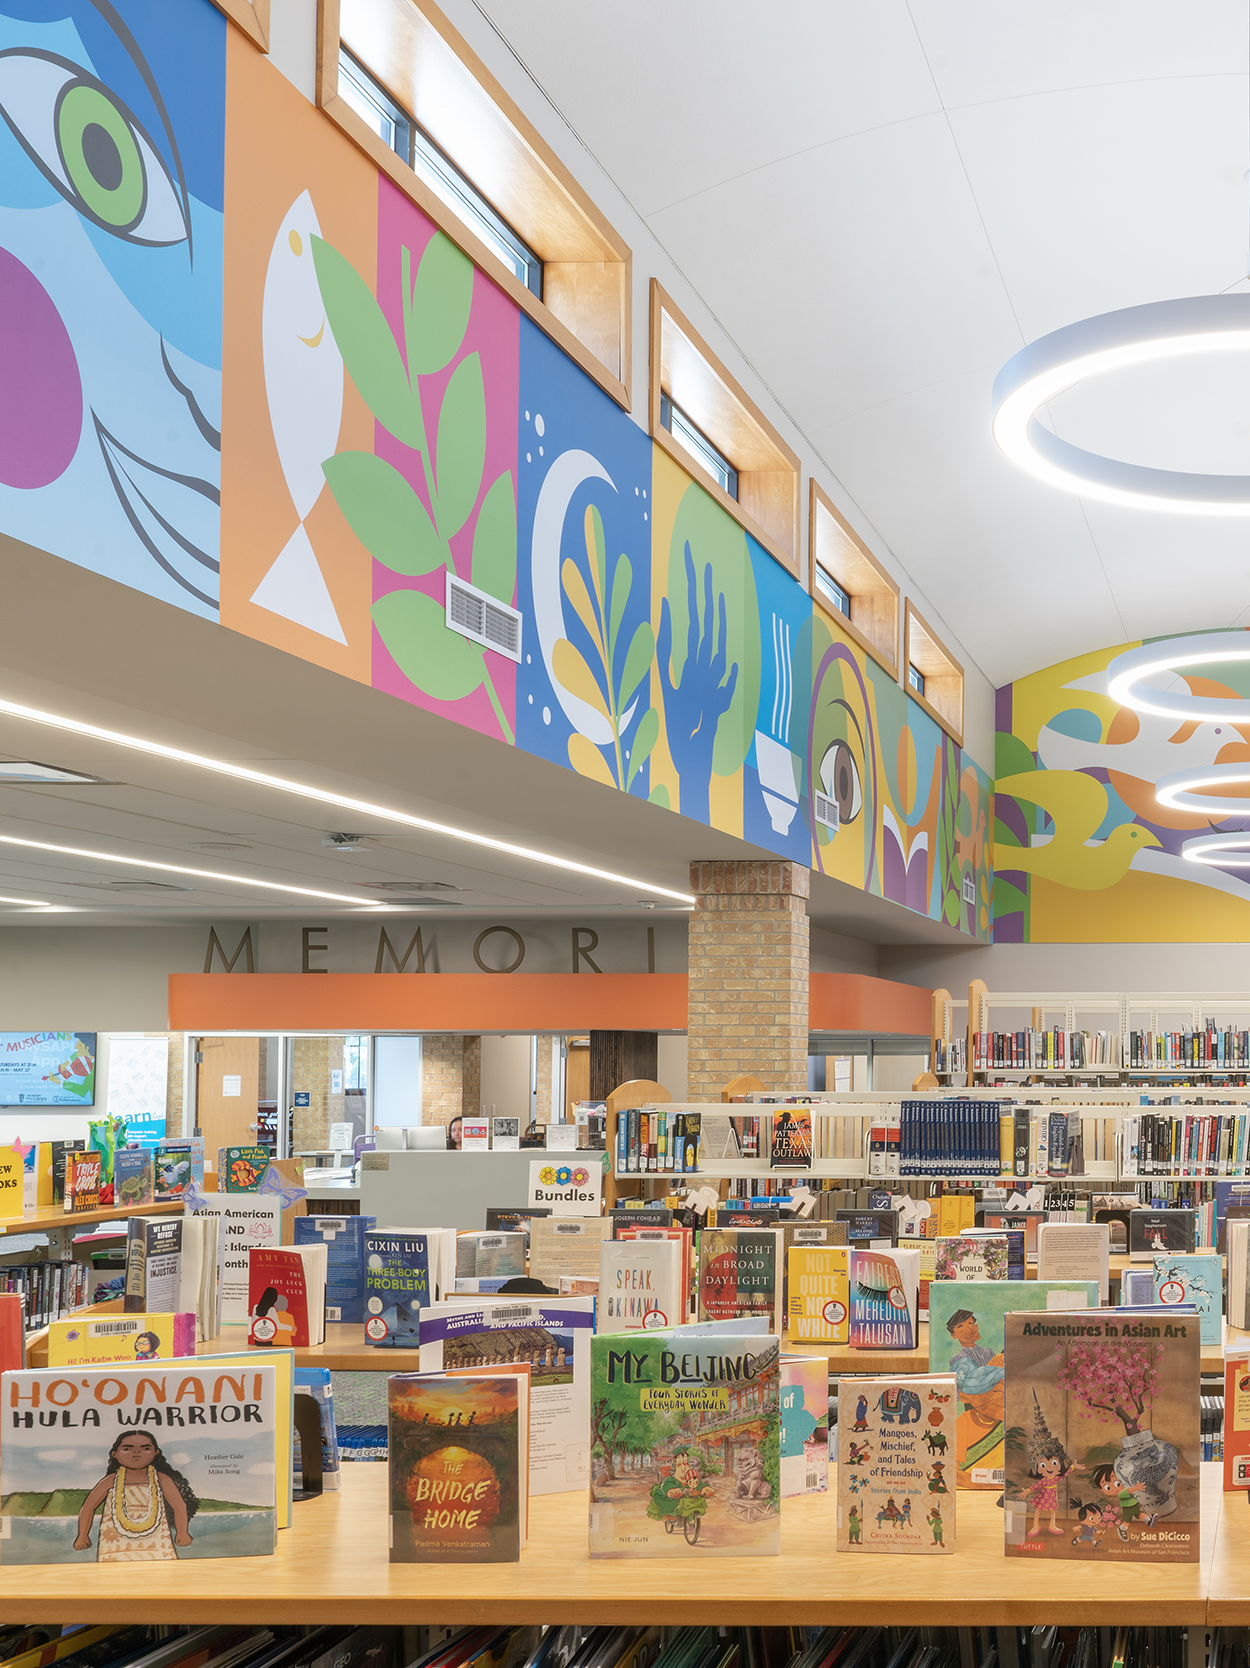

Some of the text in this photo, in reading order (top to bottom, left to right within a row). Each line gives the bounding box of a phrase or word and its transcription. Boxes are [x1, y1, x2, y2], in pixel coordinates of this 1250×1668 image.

[203, 926, 655, 974] MEMORI
[6, 1032, 72, 1052] MUSICIANS
[109, 1112, 151, 1124] earn
[784, 1122, 804, 1130] JAMES
[774, 1130, 812, 1138] PATTERSON
[774, 1137, 812, 1150] TEXAS
[772, 1148, 812, 1157] OUTLAW
[77, 1162, 100, 1177] TRIPLE
[76, 1175, 97, 1192] CROSS
[535, 1189, 594, 1202] Bundles
[192, 1208, 274, 1218] Asian American
[157, 1230, 174, 1240] REFUSE
[368, 1240, 424, 1252] CIXIN LIU
[704, 1245, 773, 1256] MIDNIGHT
[257, 1252, 300, 1264] AMY TAN
[806, 1253, 832, 1273] NOT
[723, 1260, 765, 1270] BROAD
[960, 1266, 983, 1274] WORLD
[367, 1267, 426, 1278] THREE-BODY
[856, 1261, 902, 1288] FAIREST
[367, 1278, 426, 1291] PROBLEM
[706, 1274, 770, 1286] DAYLIGHT
[800, 1275, 838, 1296] QUITE
[798, 1318, 840, 1338] WHITE
[858, 1323, 906, 1345] TALUSAN
[1022, 1322, 1187, 1338] Adventures in Asian Art
[92, 1354, 133, 1363] Katie Woo.
[607, 1350, 756, 1384] MY BEIJING
[13, 1404, 263, 1428] HULA WARRIOR
[878, 1428, 917, 1439] Mangoes,
[880, 1441, 916, 1452] Mischief,
[878, 1454, 916, 1464] and Tales
[224, 1468, 240, 1476] Song
[443, 1461, 464, 1474] THE
[870, 1468, 924, 1479] of Friendship
[415, 1478, 491, 1504] BRIDGE
[424, 1509, 482, 1529] HOME
[1130, 1532, 1190, 1542] by Sue DiCicco
[415, 1540, 490, 1548] Padma Venkatraman
